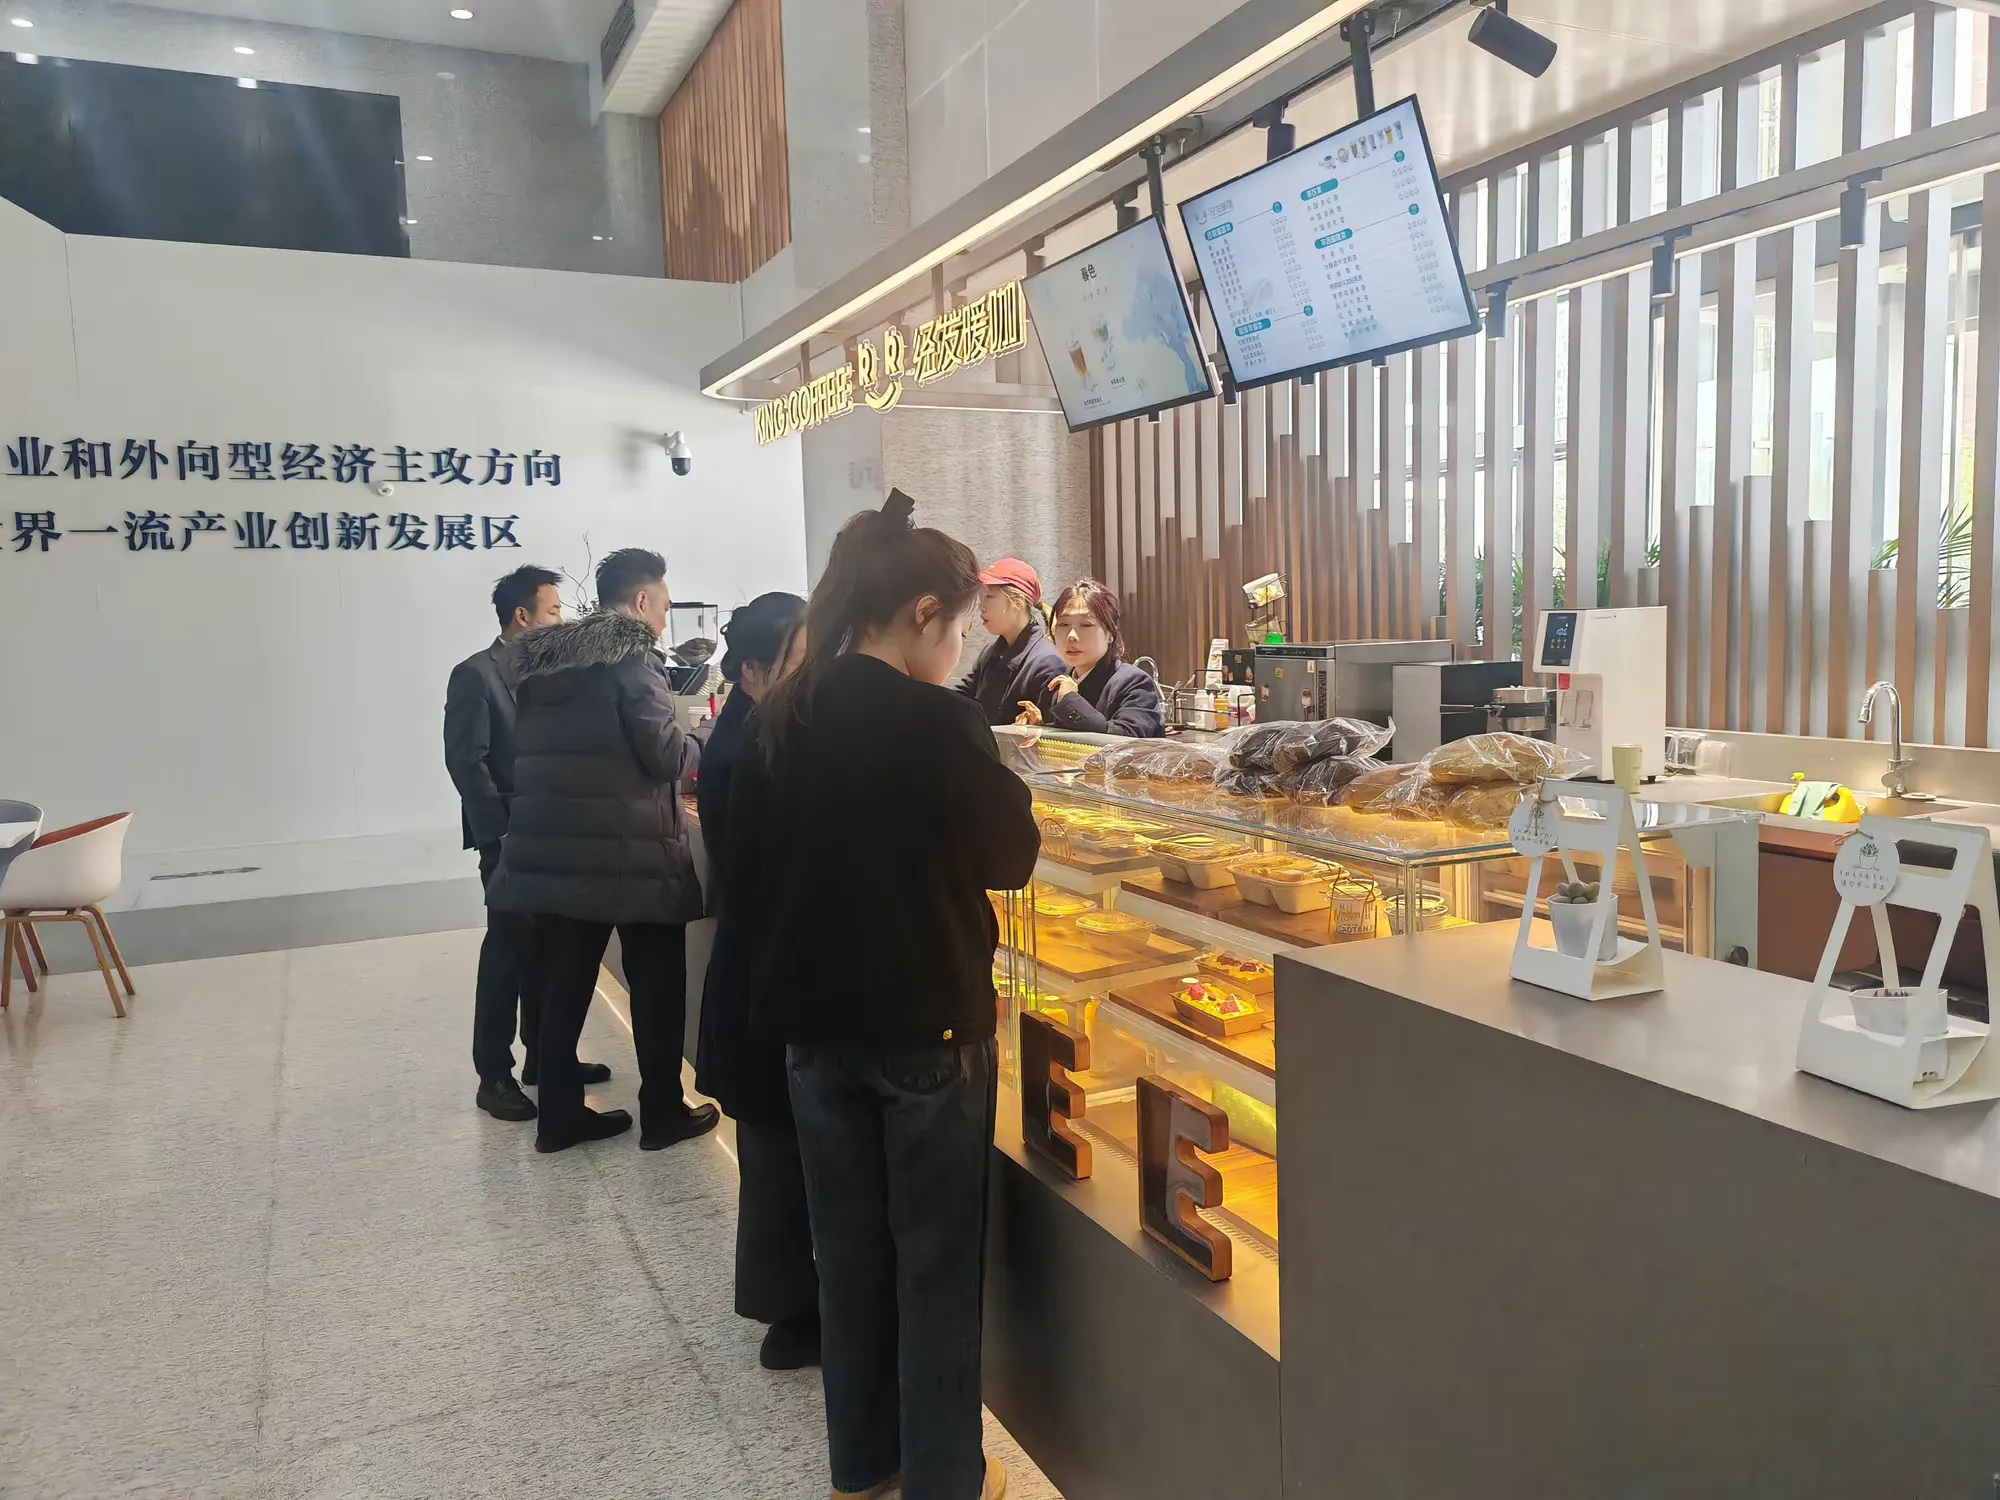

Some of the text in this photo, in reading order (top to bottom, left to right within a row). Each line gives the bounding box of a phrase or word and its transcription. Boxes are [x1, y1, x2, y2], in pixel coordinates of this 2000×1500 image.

[913, 279, 1026, 384] 经发暖咖
[755, 364, 852, 445] KING COFFEE
[2, 436, 562, 488] 业和外向型经济主攻方向
[0, 509, 523, 553] 界一流产业创新发展区
